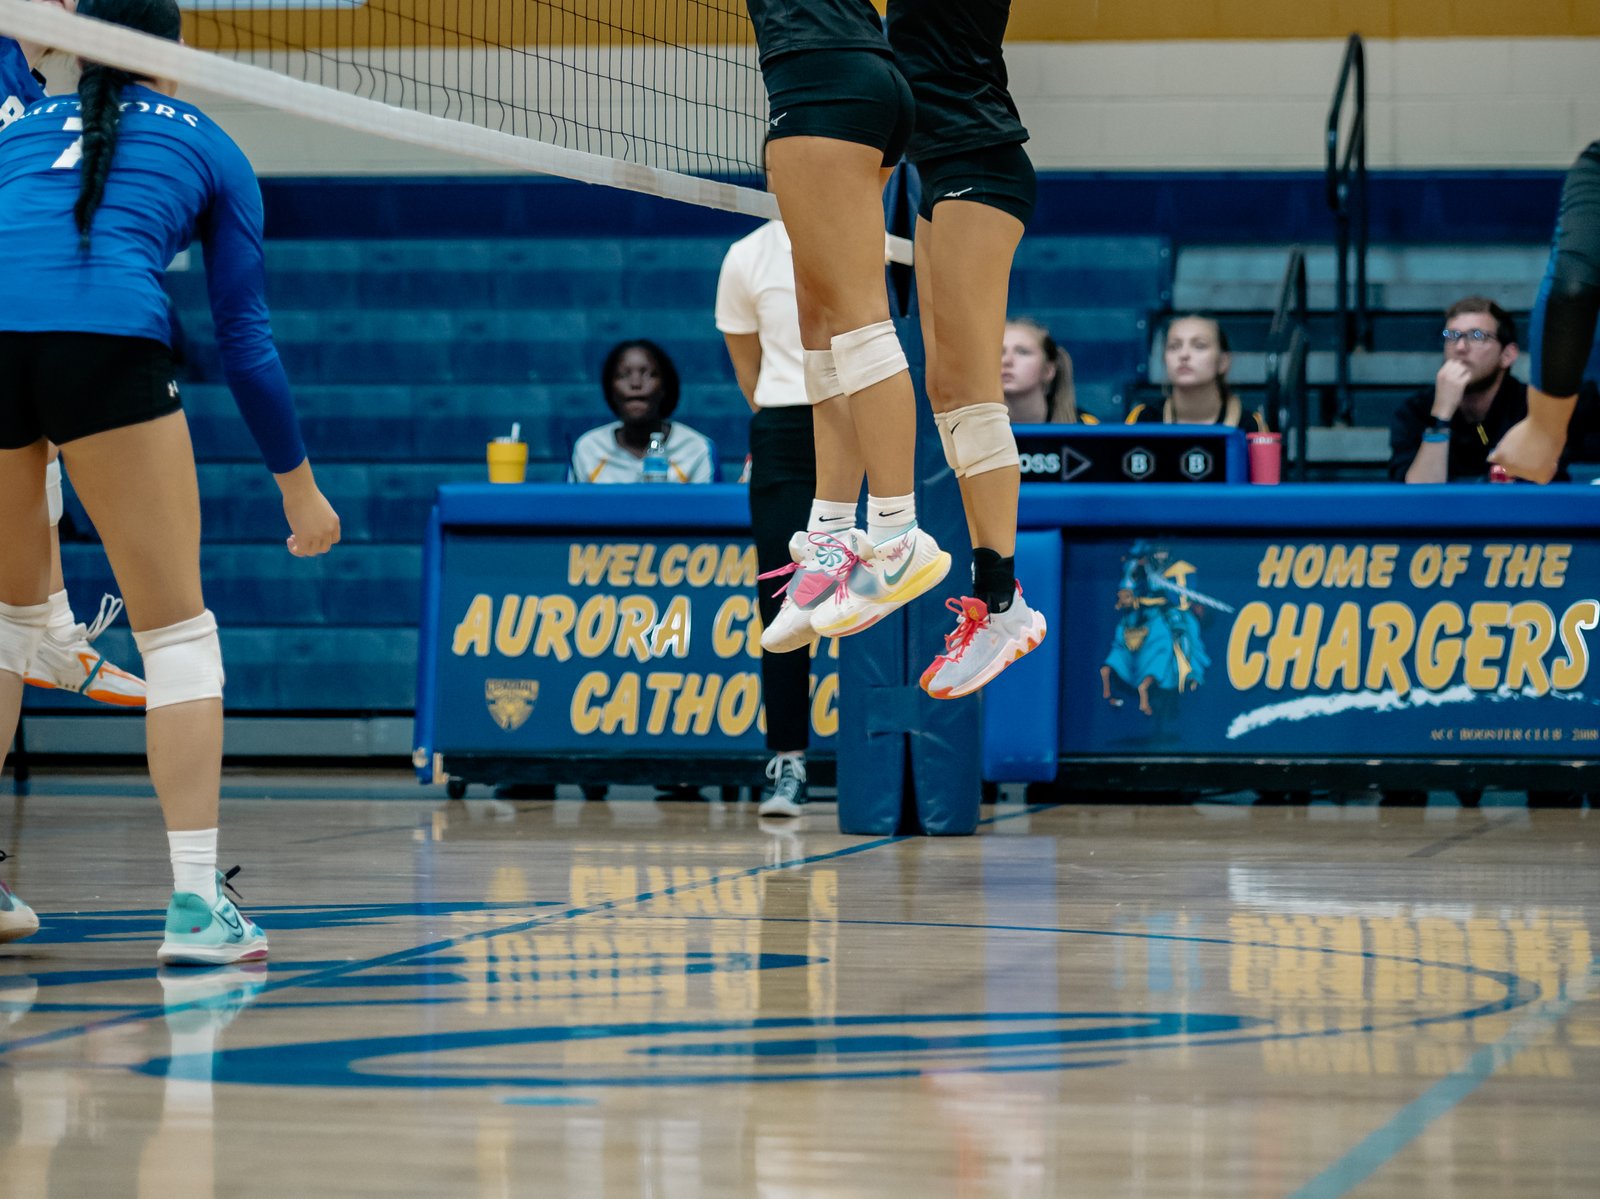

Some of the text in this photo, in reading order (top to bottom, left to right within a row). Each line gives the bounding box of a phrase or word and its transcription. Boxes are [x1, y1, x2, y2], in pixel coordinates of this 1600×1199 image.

[567, 543, 759, 588] WELCOM
[1257, 544, 1573, 589] HOME OF THE
[451, 594, 692, 663] AURORA
[1226, 599, 1600, 697] CHARGERS
[569, 670, 840, 737] CATHOC
